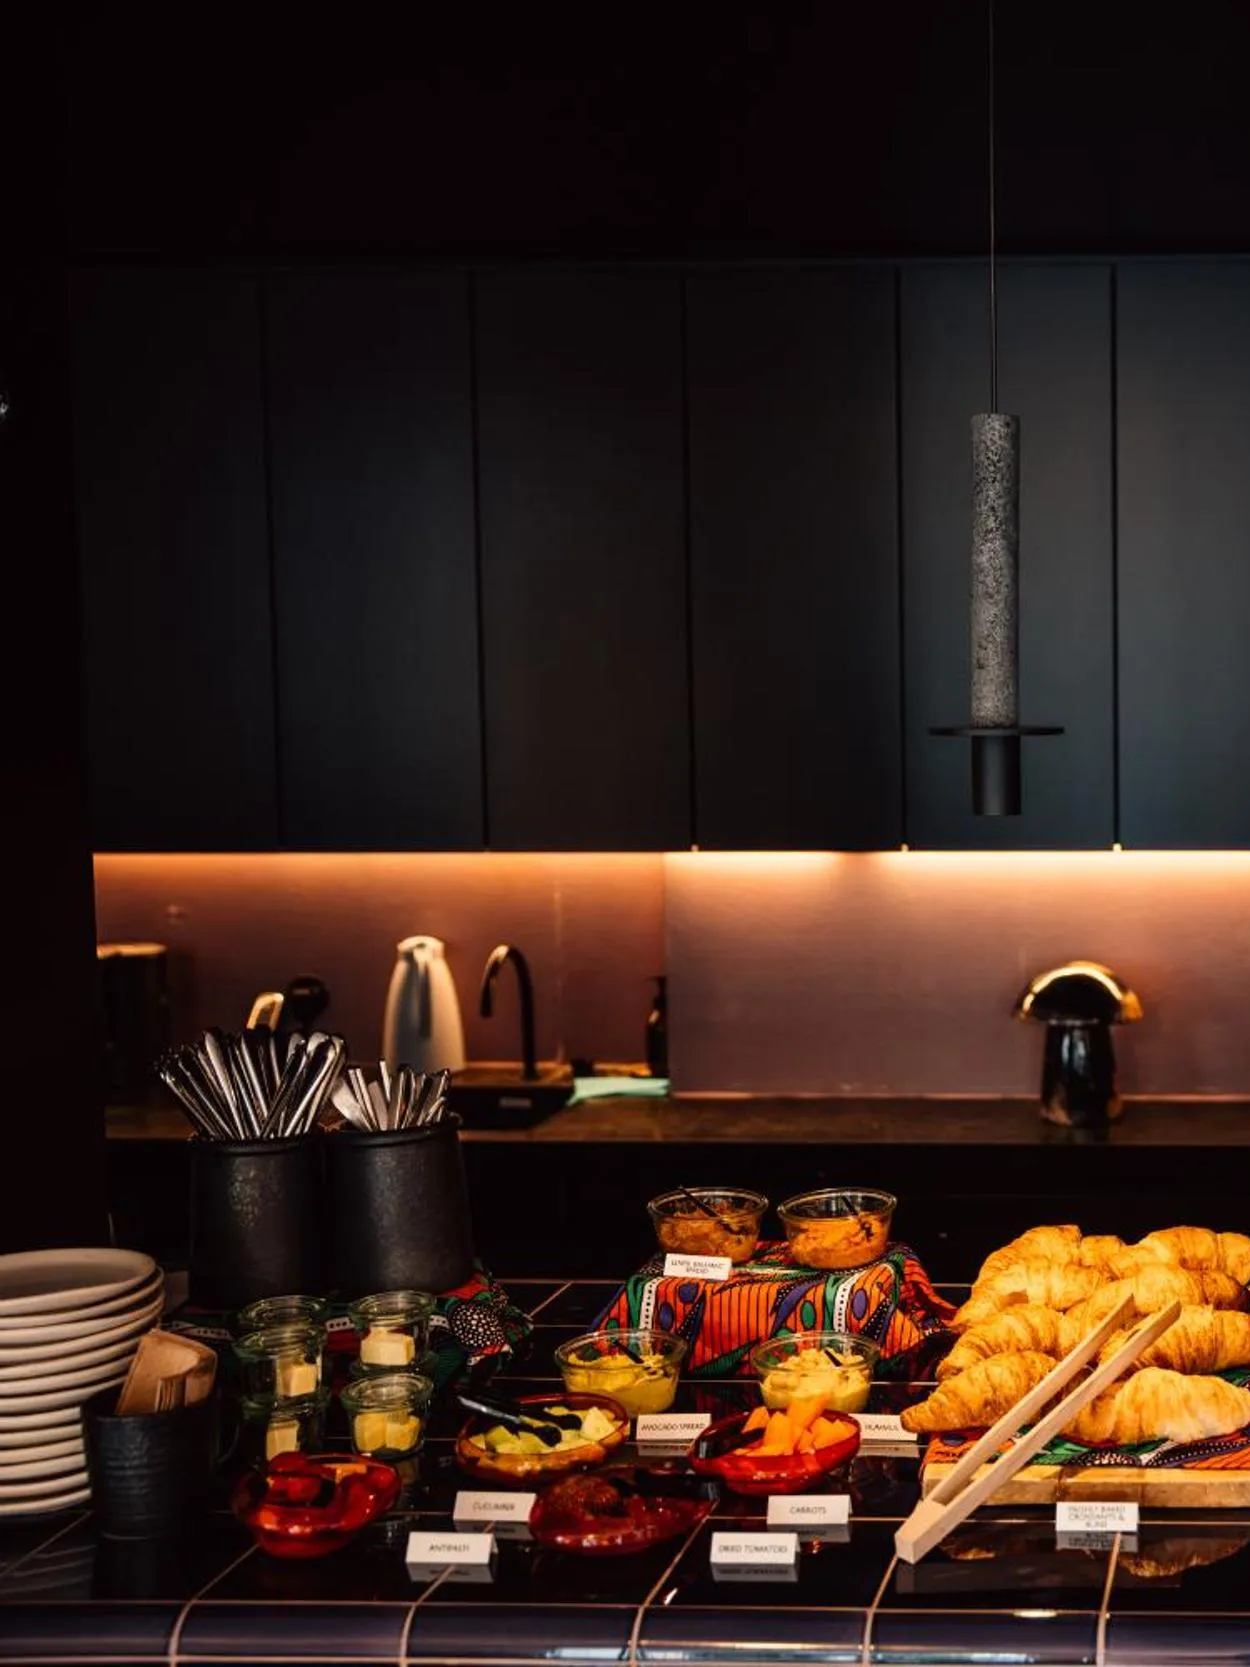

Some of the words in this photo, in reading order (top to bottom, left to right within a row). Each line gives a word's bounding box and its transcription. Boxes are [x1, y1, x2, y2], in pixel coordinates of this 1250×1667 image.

[789, 1506, 827, 1514] CARROTS
[718, 1545, 742, 1553] DRIED
[744, 1545, 788, 1553] TOMATOES
